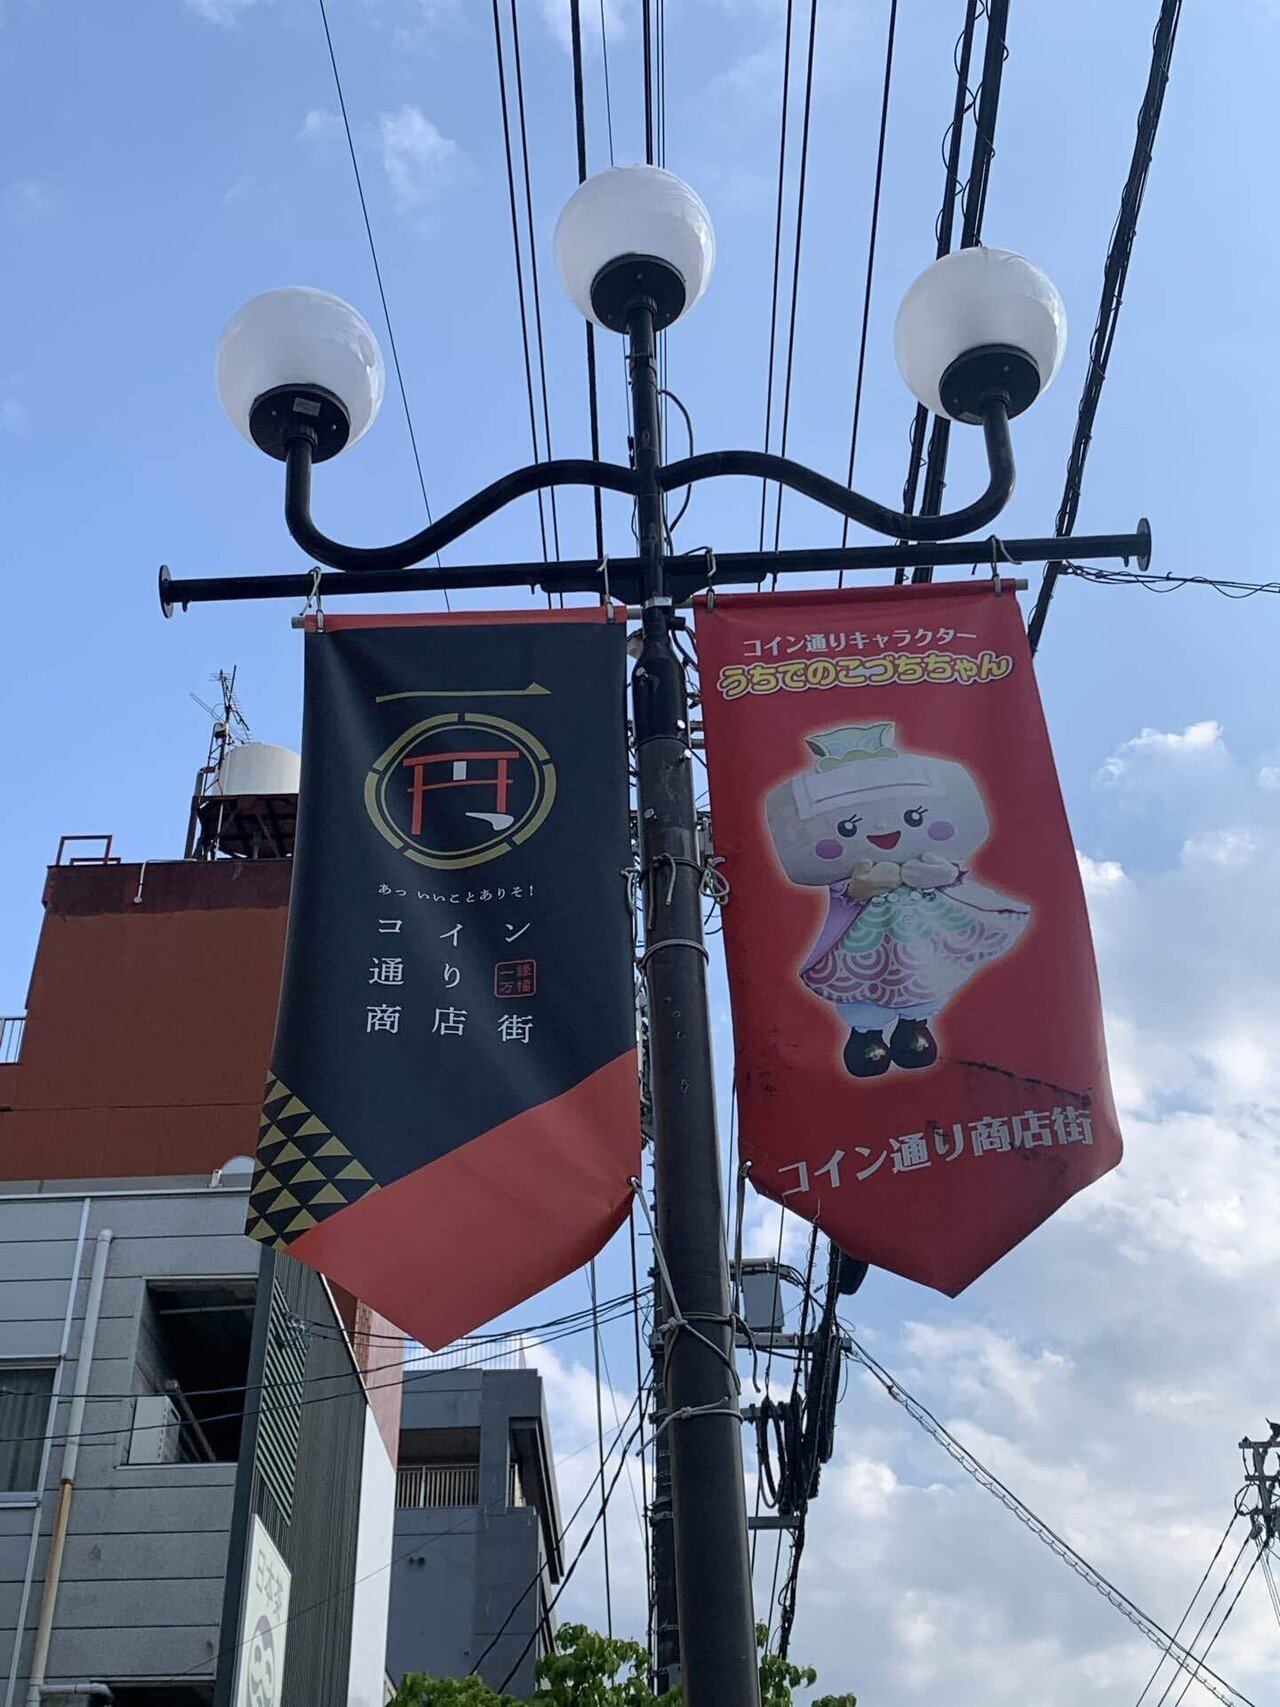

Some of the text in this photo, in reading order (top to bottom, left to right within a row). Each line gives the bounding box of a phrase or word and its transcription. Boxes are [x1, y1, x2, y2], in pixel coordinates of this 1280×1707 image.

[742, 627, 978, 658] コイン通りキャラクター
[717, 650, 1014, 700] うちでのこづちちゃん
[365, 1003, 535, 1045] 商店街
[777, 1105, 1095, 1197] コイン通り商店街
